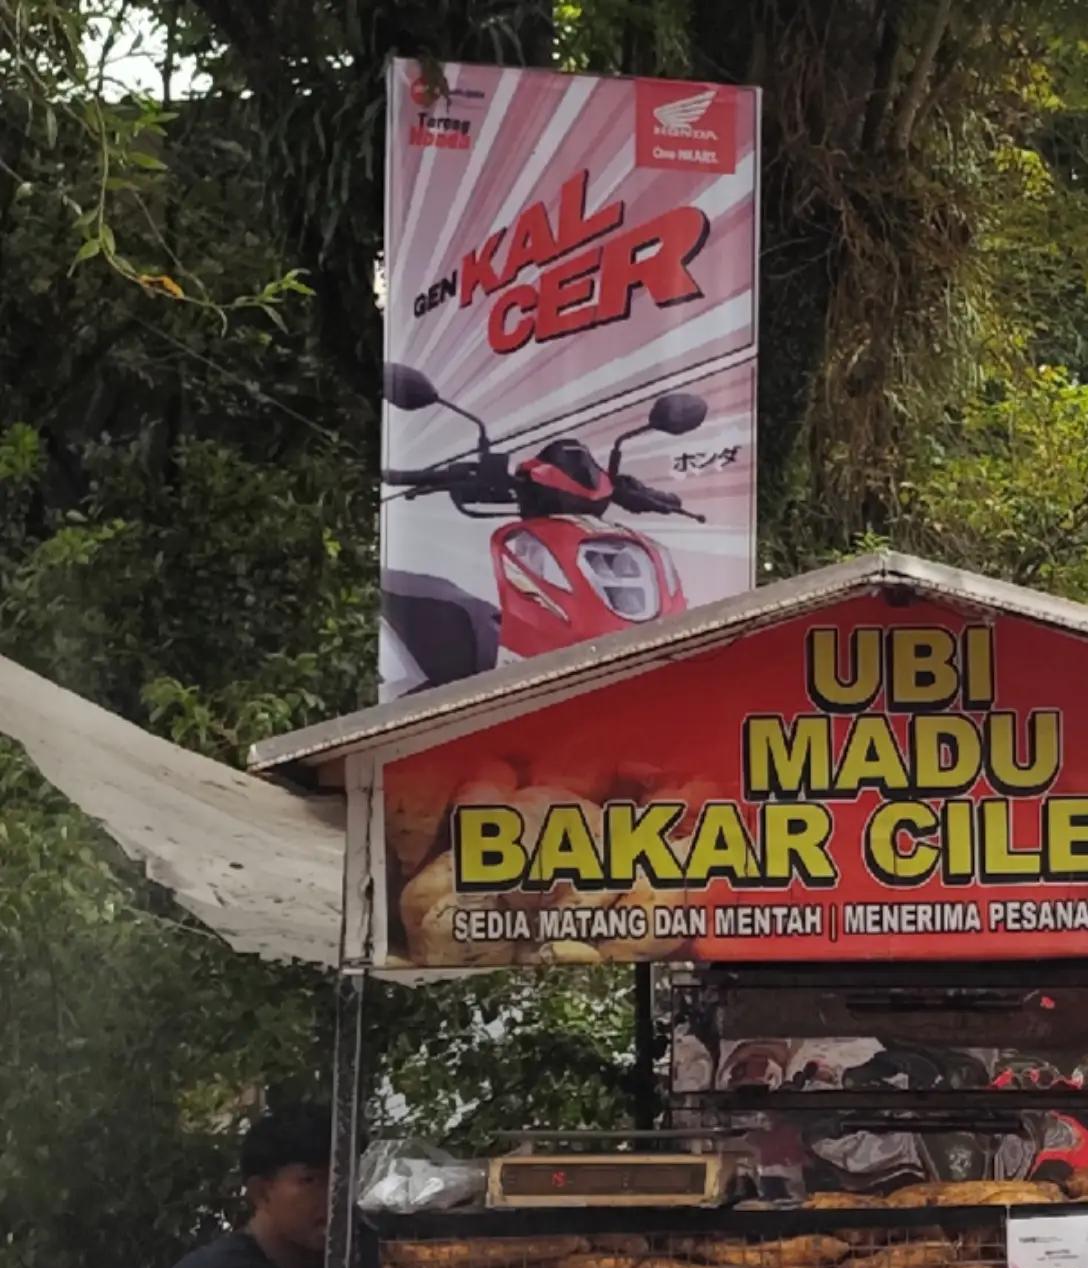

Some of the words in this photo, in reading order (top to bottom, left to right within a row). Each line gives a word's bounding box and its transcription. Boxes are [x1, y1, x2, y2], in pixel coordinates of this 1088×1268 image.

[653, 124, 718, 141] HONDA
[413, 270, 457, 318] GEN
[459, 168, 624, 309] KAL
[487, 206, 710, 354] CER
[673, 444, 742, 472] ホンダ
[806, 624, 995, 714] UBI
[743, 709, 1062, 801] MADU
[452, 800, 838, 890] BAKAR
[453, 909, 532, 942] SEDIA
[539, 907, 648, 940] MATANG
[653, 906, 707, 938] DAN
[713, 904, 823, 936] MENTAH
[843, 902, 982, 936] MENERIMA
